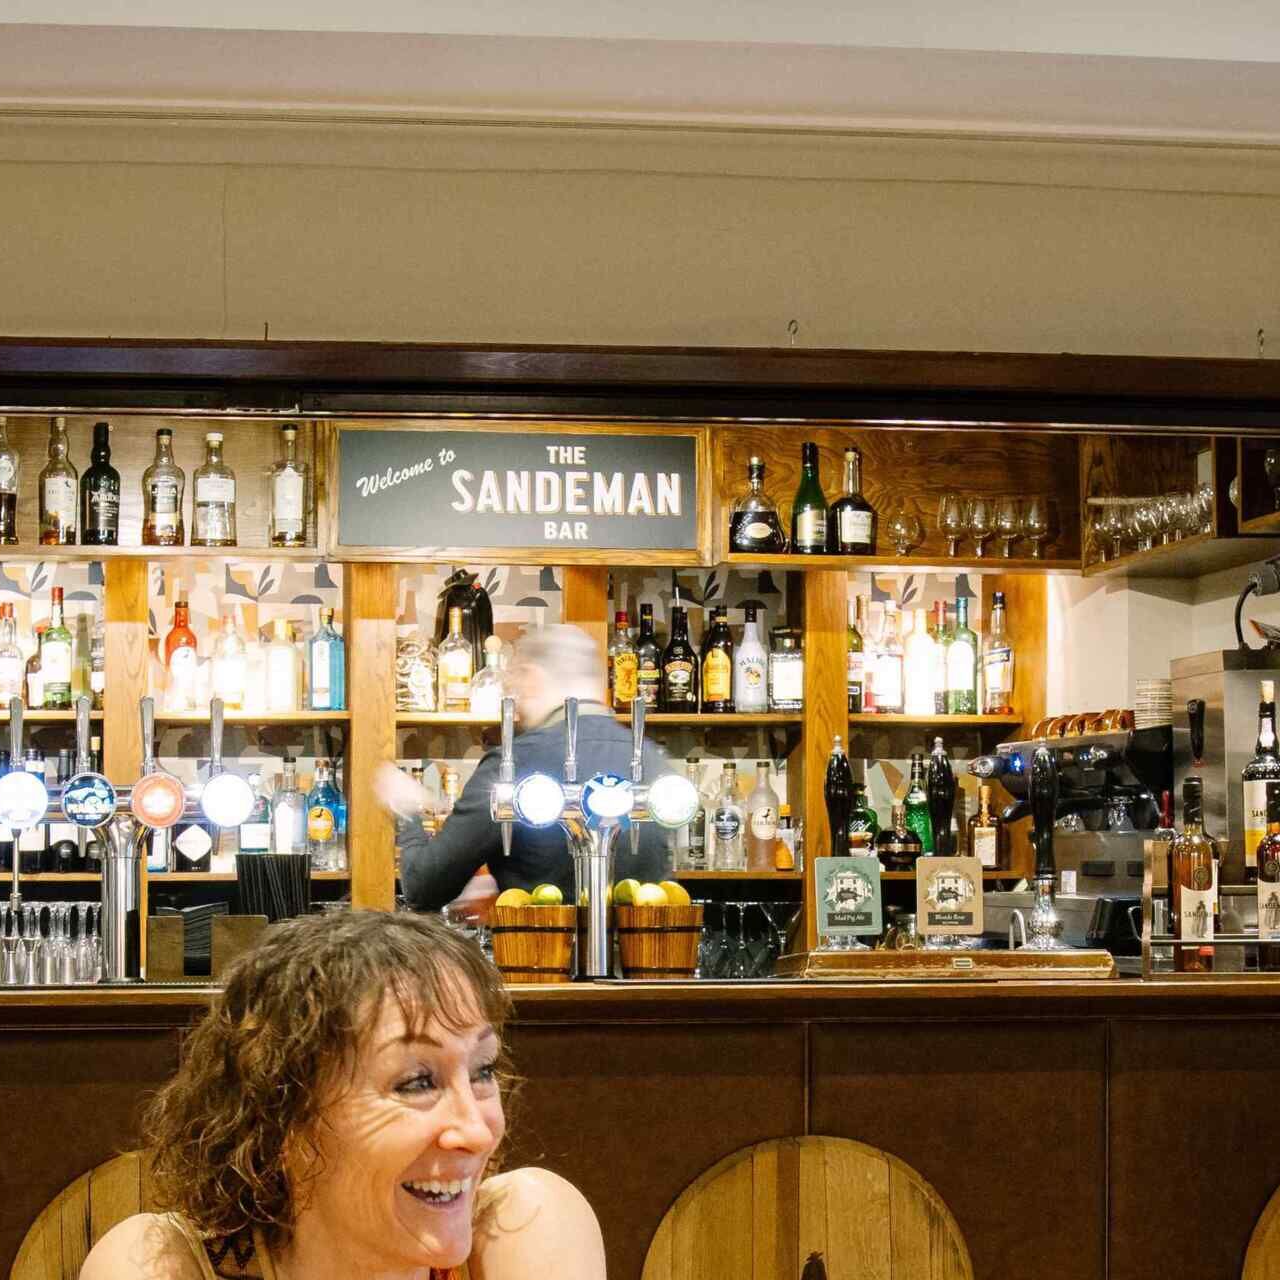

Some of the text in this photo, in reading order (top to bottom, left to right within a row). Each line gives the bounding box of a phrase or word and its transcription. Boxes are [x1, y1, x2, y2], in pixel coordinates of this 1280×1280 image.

[355, 447, 457, 497] Welcome to
[546, 446, 587, 465] THE
[451, 468, 682, 516] SANDEMAN
[543, 521, 589, 540] BAR
